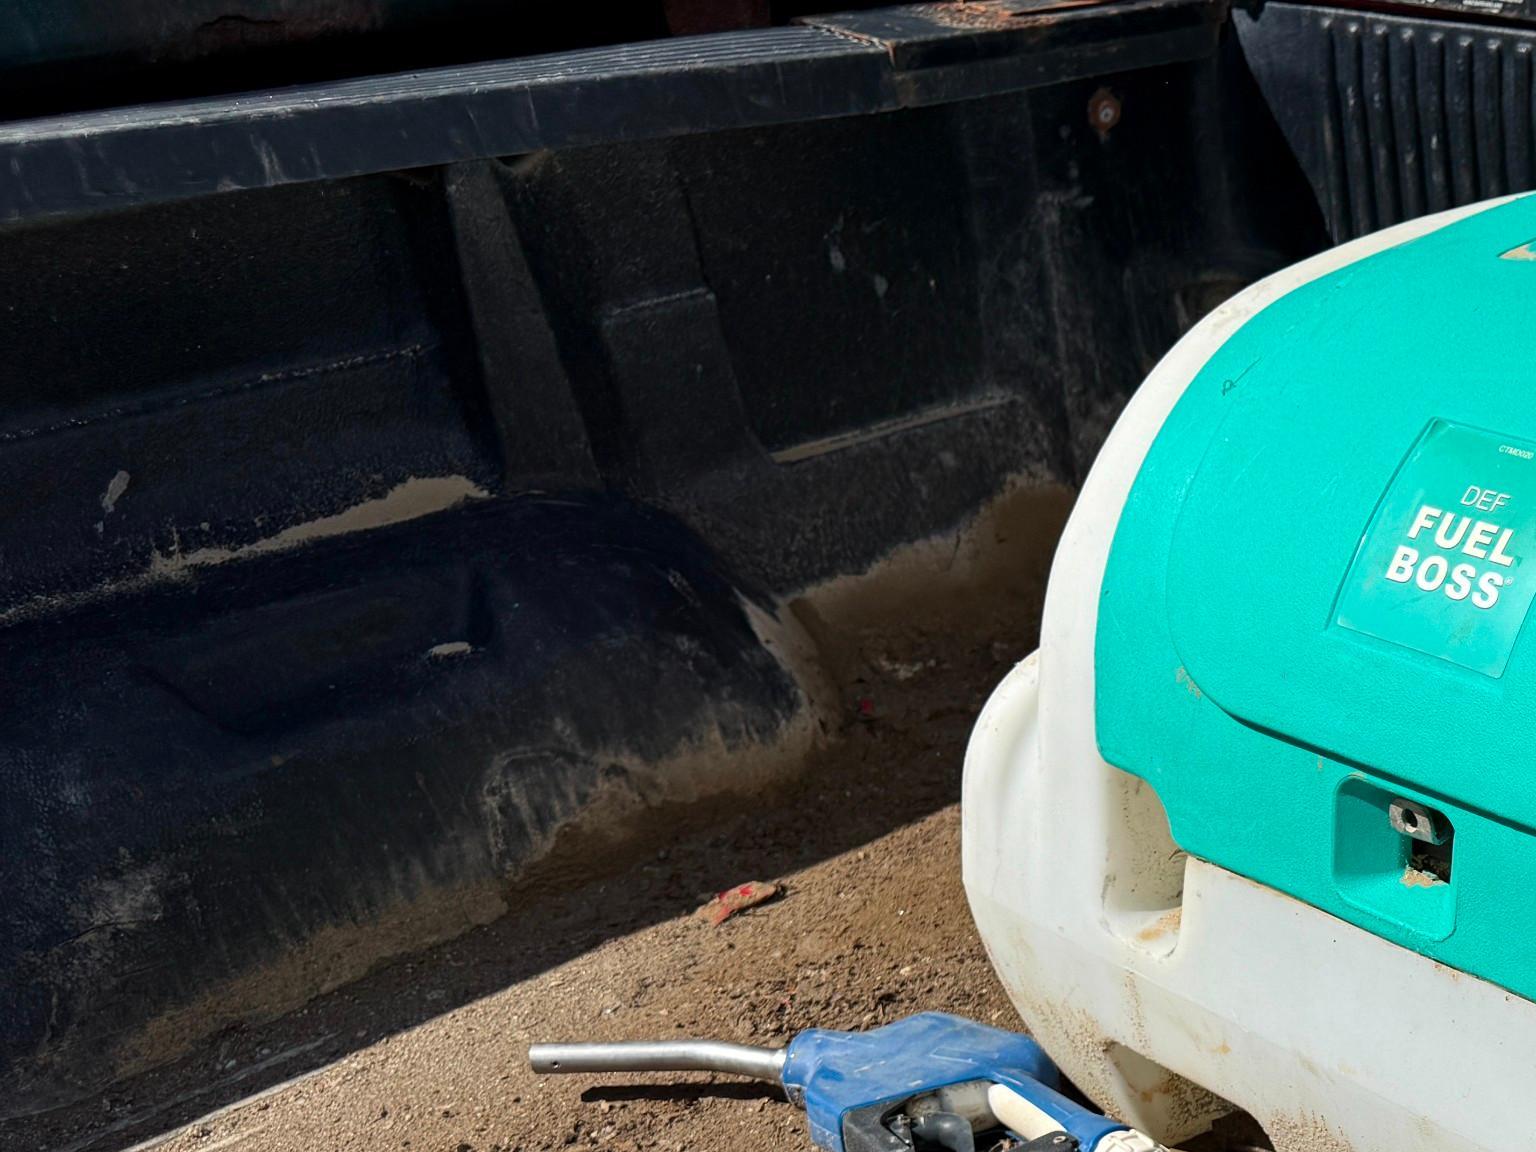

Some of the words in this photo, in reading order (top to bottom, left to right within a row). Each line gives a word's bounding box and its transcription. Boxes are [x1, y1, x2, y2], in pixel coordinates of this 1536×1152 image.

[1460, 485, 1511, 512] DEF
[1407, 505, 1514, 567] FUEL
[1385, 545, 1504, 609] BOSS
